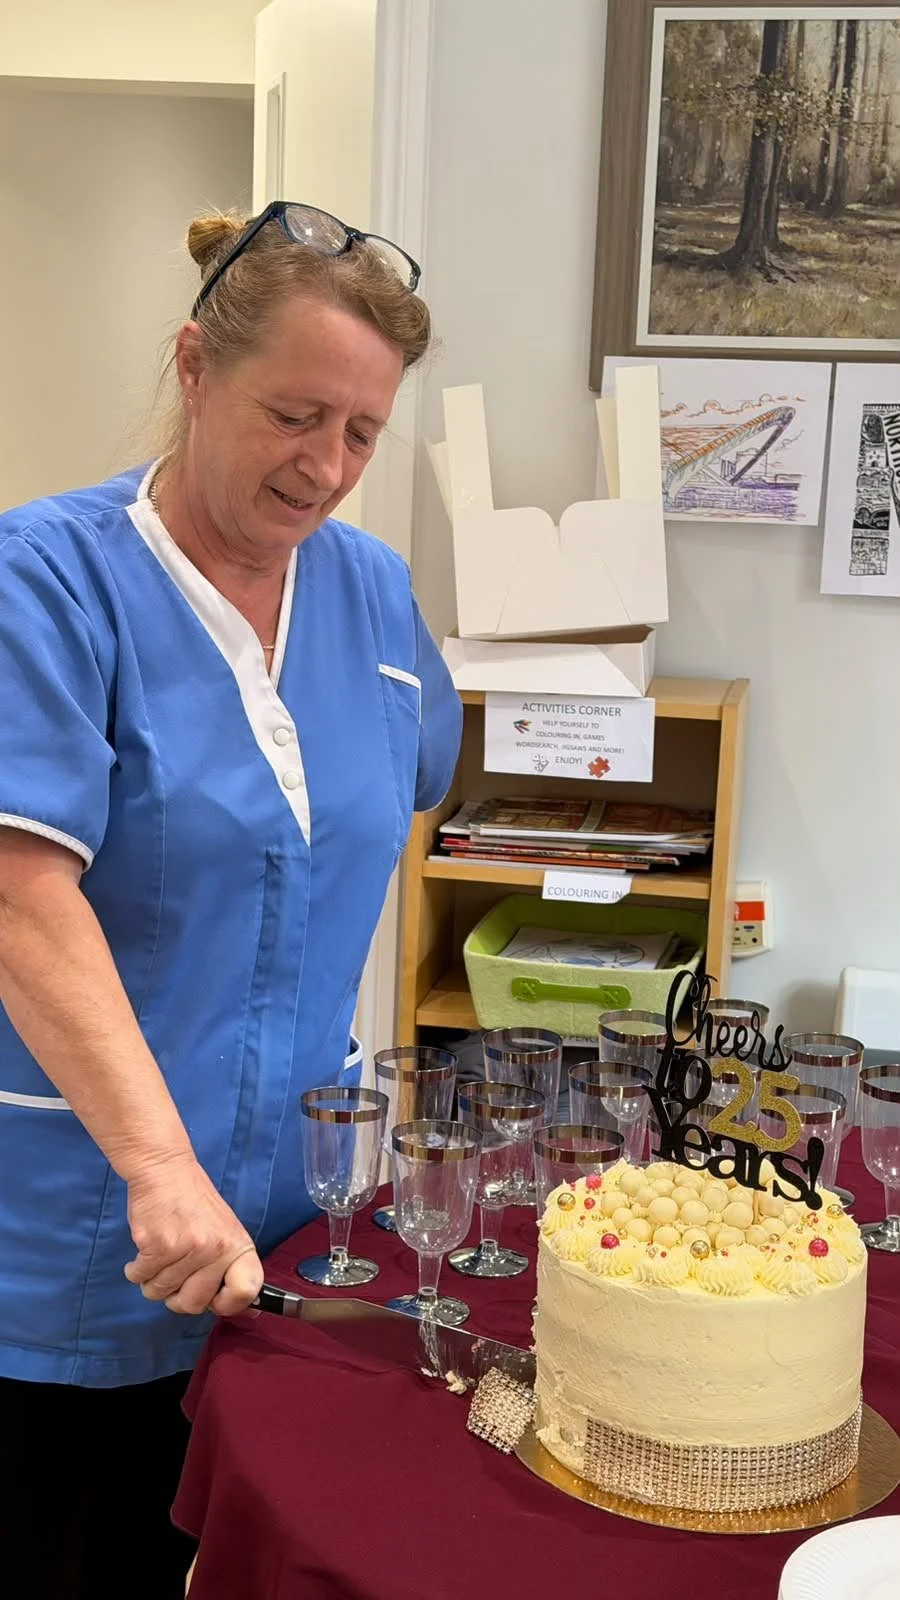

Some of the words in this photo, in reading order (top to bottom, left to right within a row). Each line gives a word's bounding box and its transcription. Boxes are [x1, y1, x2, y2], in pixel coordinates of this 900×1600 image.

[522, 702, 576, 714] ACTIVITIES
[579, 705, 622, 717] CORNER
[559, 721, 590, 729] YOURSELF
[536, 730, 572, 739] COLOURING
[561, 744, 587, 752] JIGSAWS
[555, 756, 583, 765] ENJOY!
[547, 886, 609, 899] COLOURING
[611, 890, 623, 899] IN
[665, 969, 793, 1073] Cheers
[654, 1047, 713, 1105] to
[708, 1056, 801, 1151] 25
[641, 1083, 825, 1211] Years!
